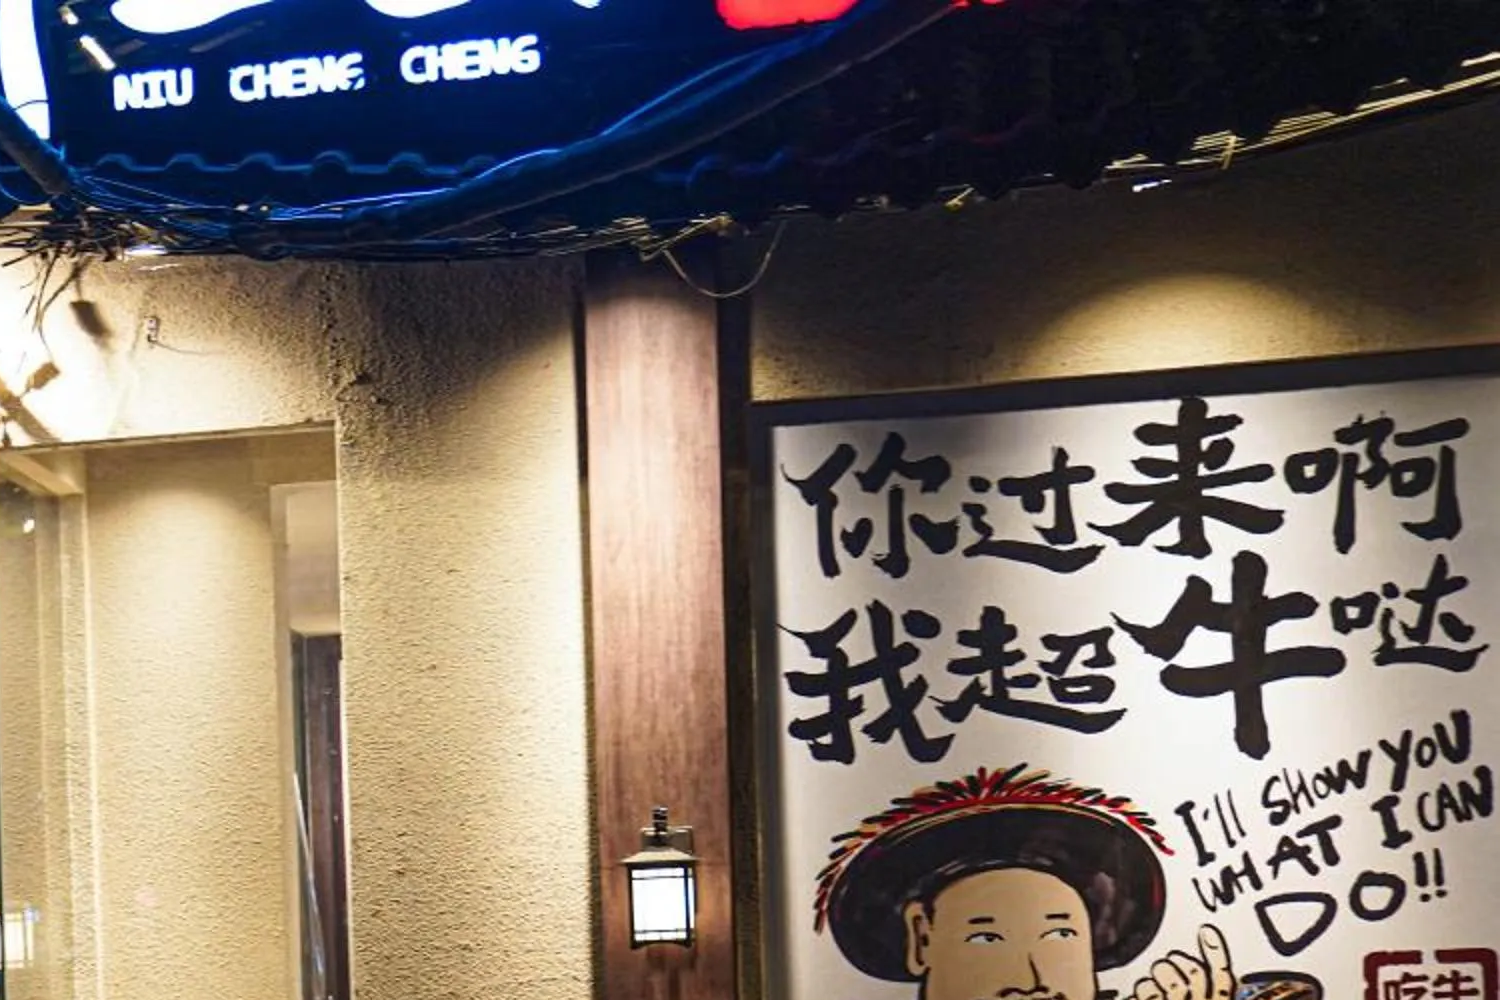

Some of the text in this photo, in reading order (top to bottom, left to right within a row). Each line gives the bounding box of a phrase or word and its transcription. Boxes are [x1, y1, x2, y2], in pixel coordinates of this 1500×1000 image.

[113, 34, 541, 111] NIU CHENG CHENG
[780, 395, 1470, 578] 你过来啊
[777, 550, 1489, 765] 我超牛哒
[1191, 764, 1494, 913] WHAT I CAN
[1261, 749, 1373, 826] SHOW
[1378, 709, 1472, 793] YOU
